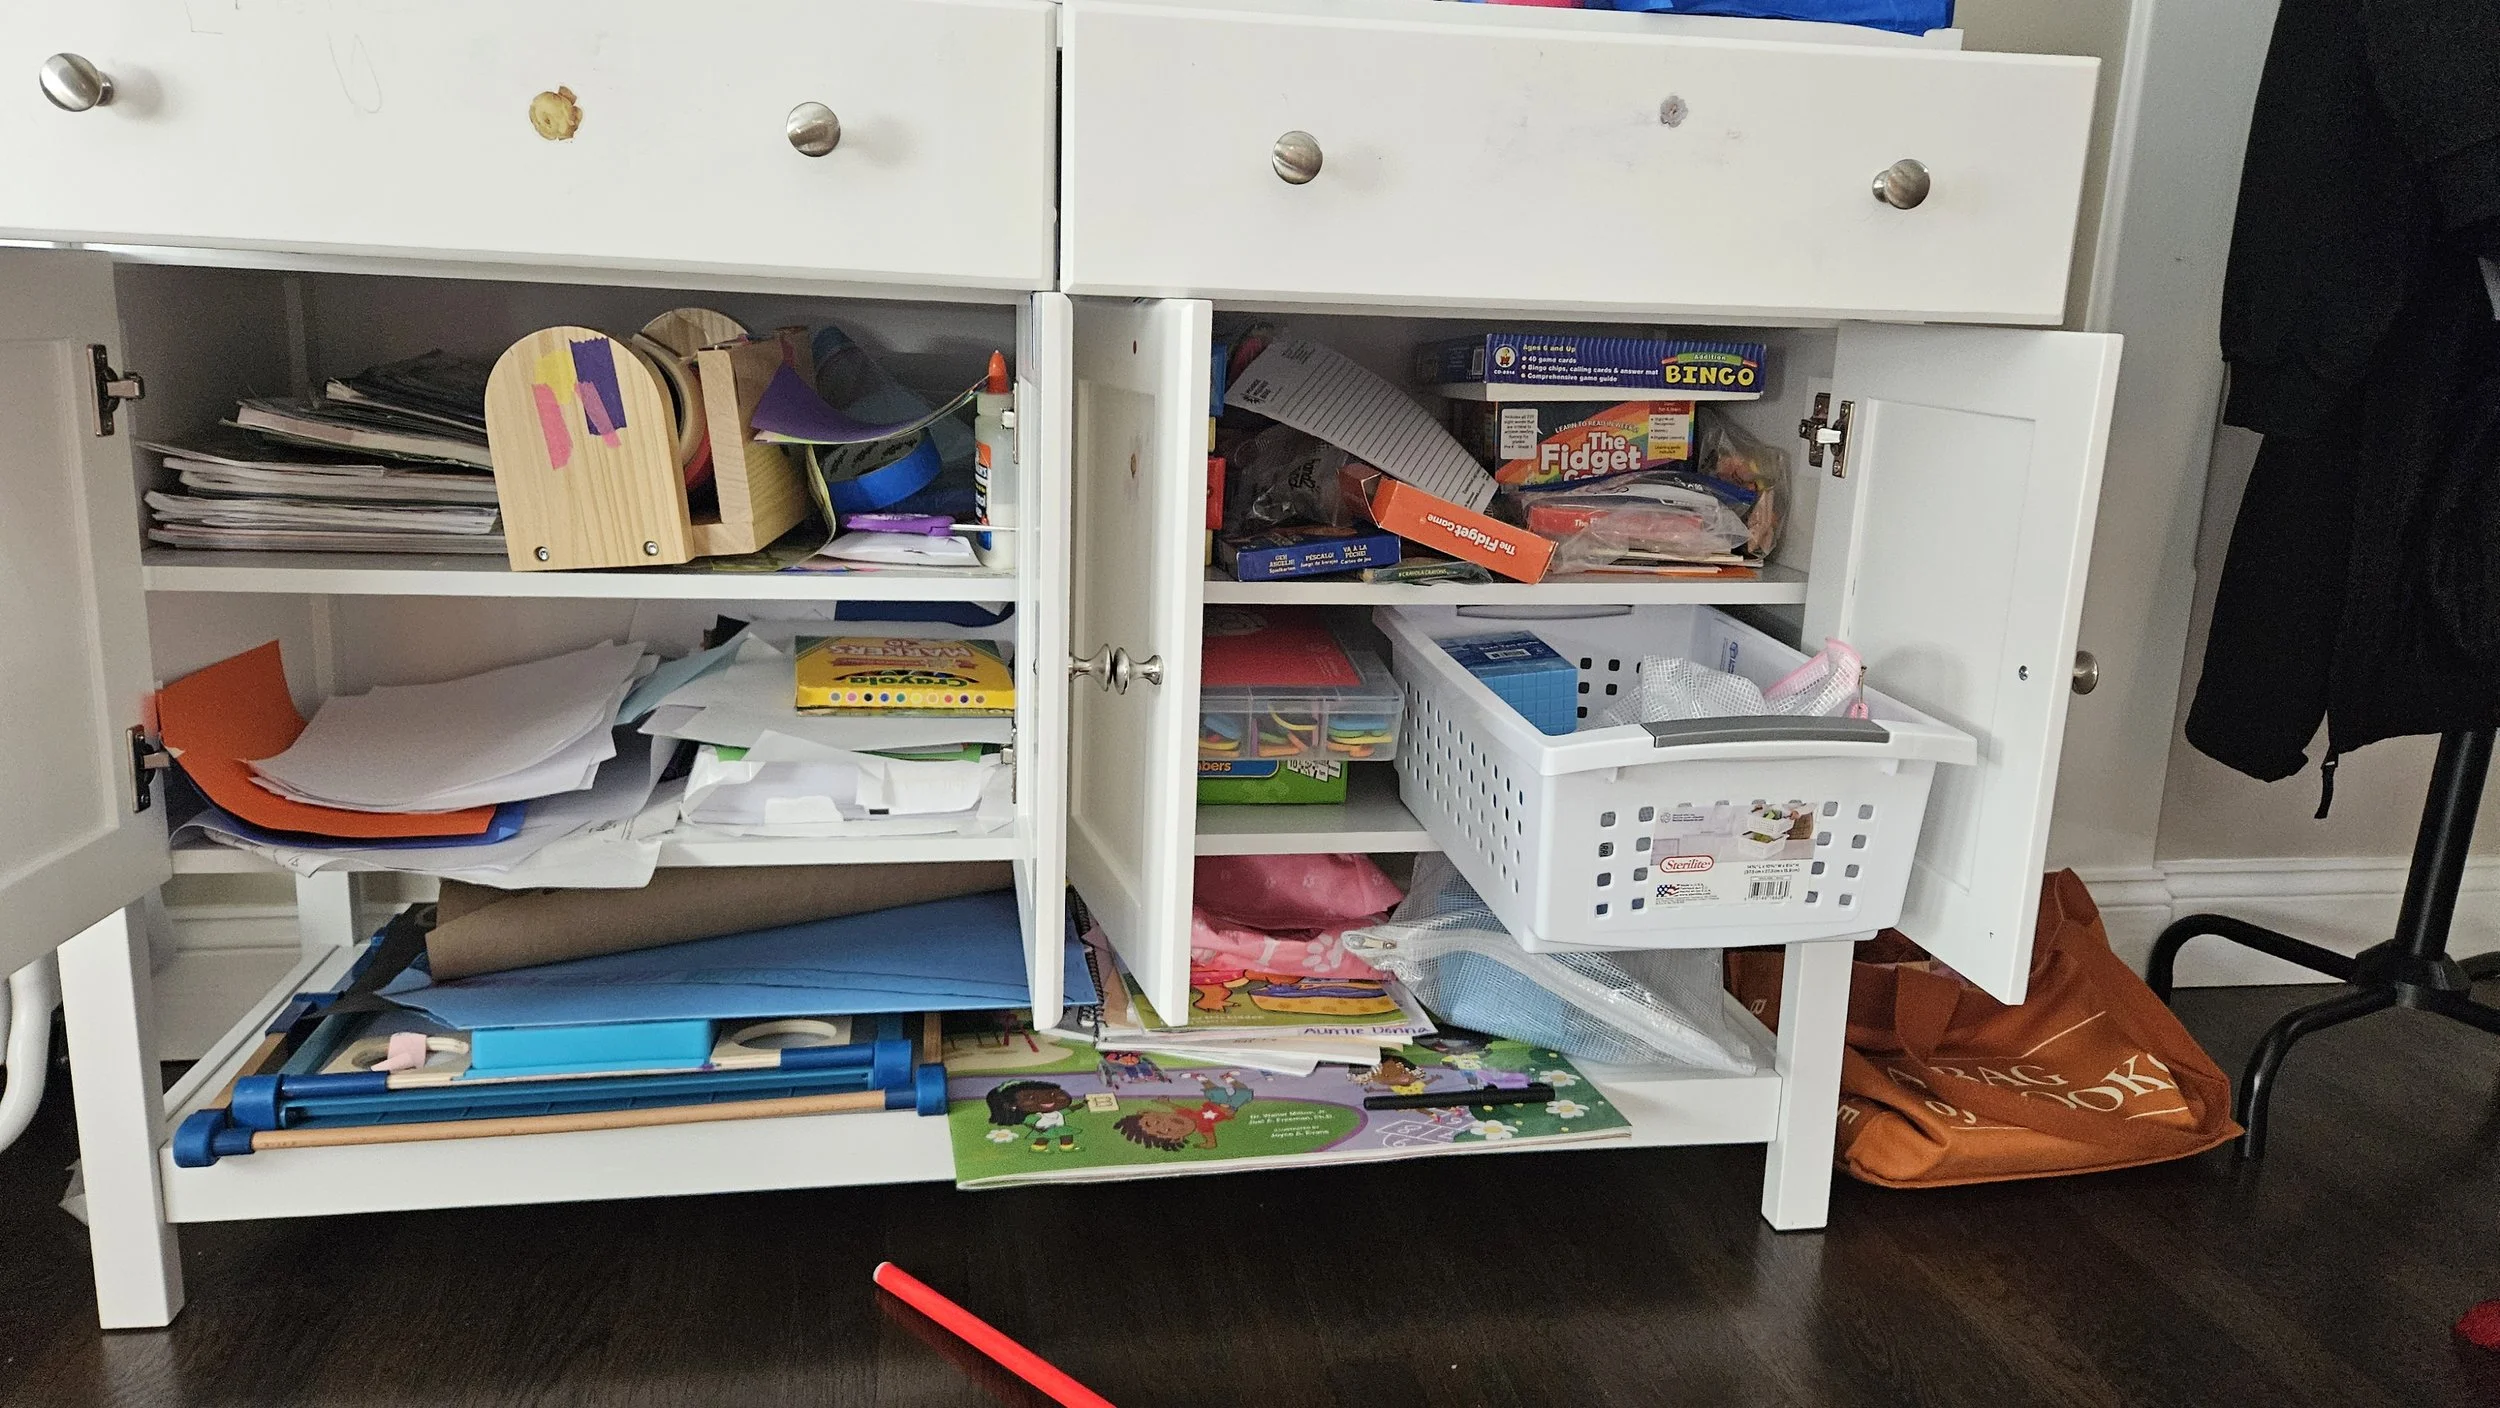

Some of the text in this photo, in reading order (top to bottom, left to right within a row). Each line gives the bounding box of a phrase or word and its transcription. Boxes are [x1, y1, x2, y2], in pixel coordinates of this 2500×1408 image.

[1523, 344, 1540, 352] Ages
[1528, 364, 1547, 372] Bingo
[1548, 365, 1568, 373] chips,
[1570, 366, 1592, 374] calling
[1527, 373, 1578, 381] Comprehensive
[1665, 365, 1755, 386] BINGO
[1554, 422, 1577, 433] LEARN
[1588, 431, 1626, 450] The
[1541, 442, 1641, 475] Fidget
[1427, 514, 1516, 556] The Fidget Game
[828, 644, 973, 658] MARKERS
[849, 676, 968, 687] Crayola
[1666, 858, 1708, 870] Sterilite
